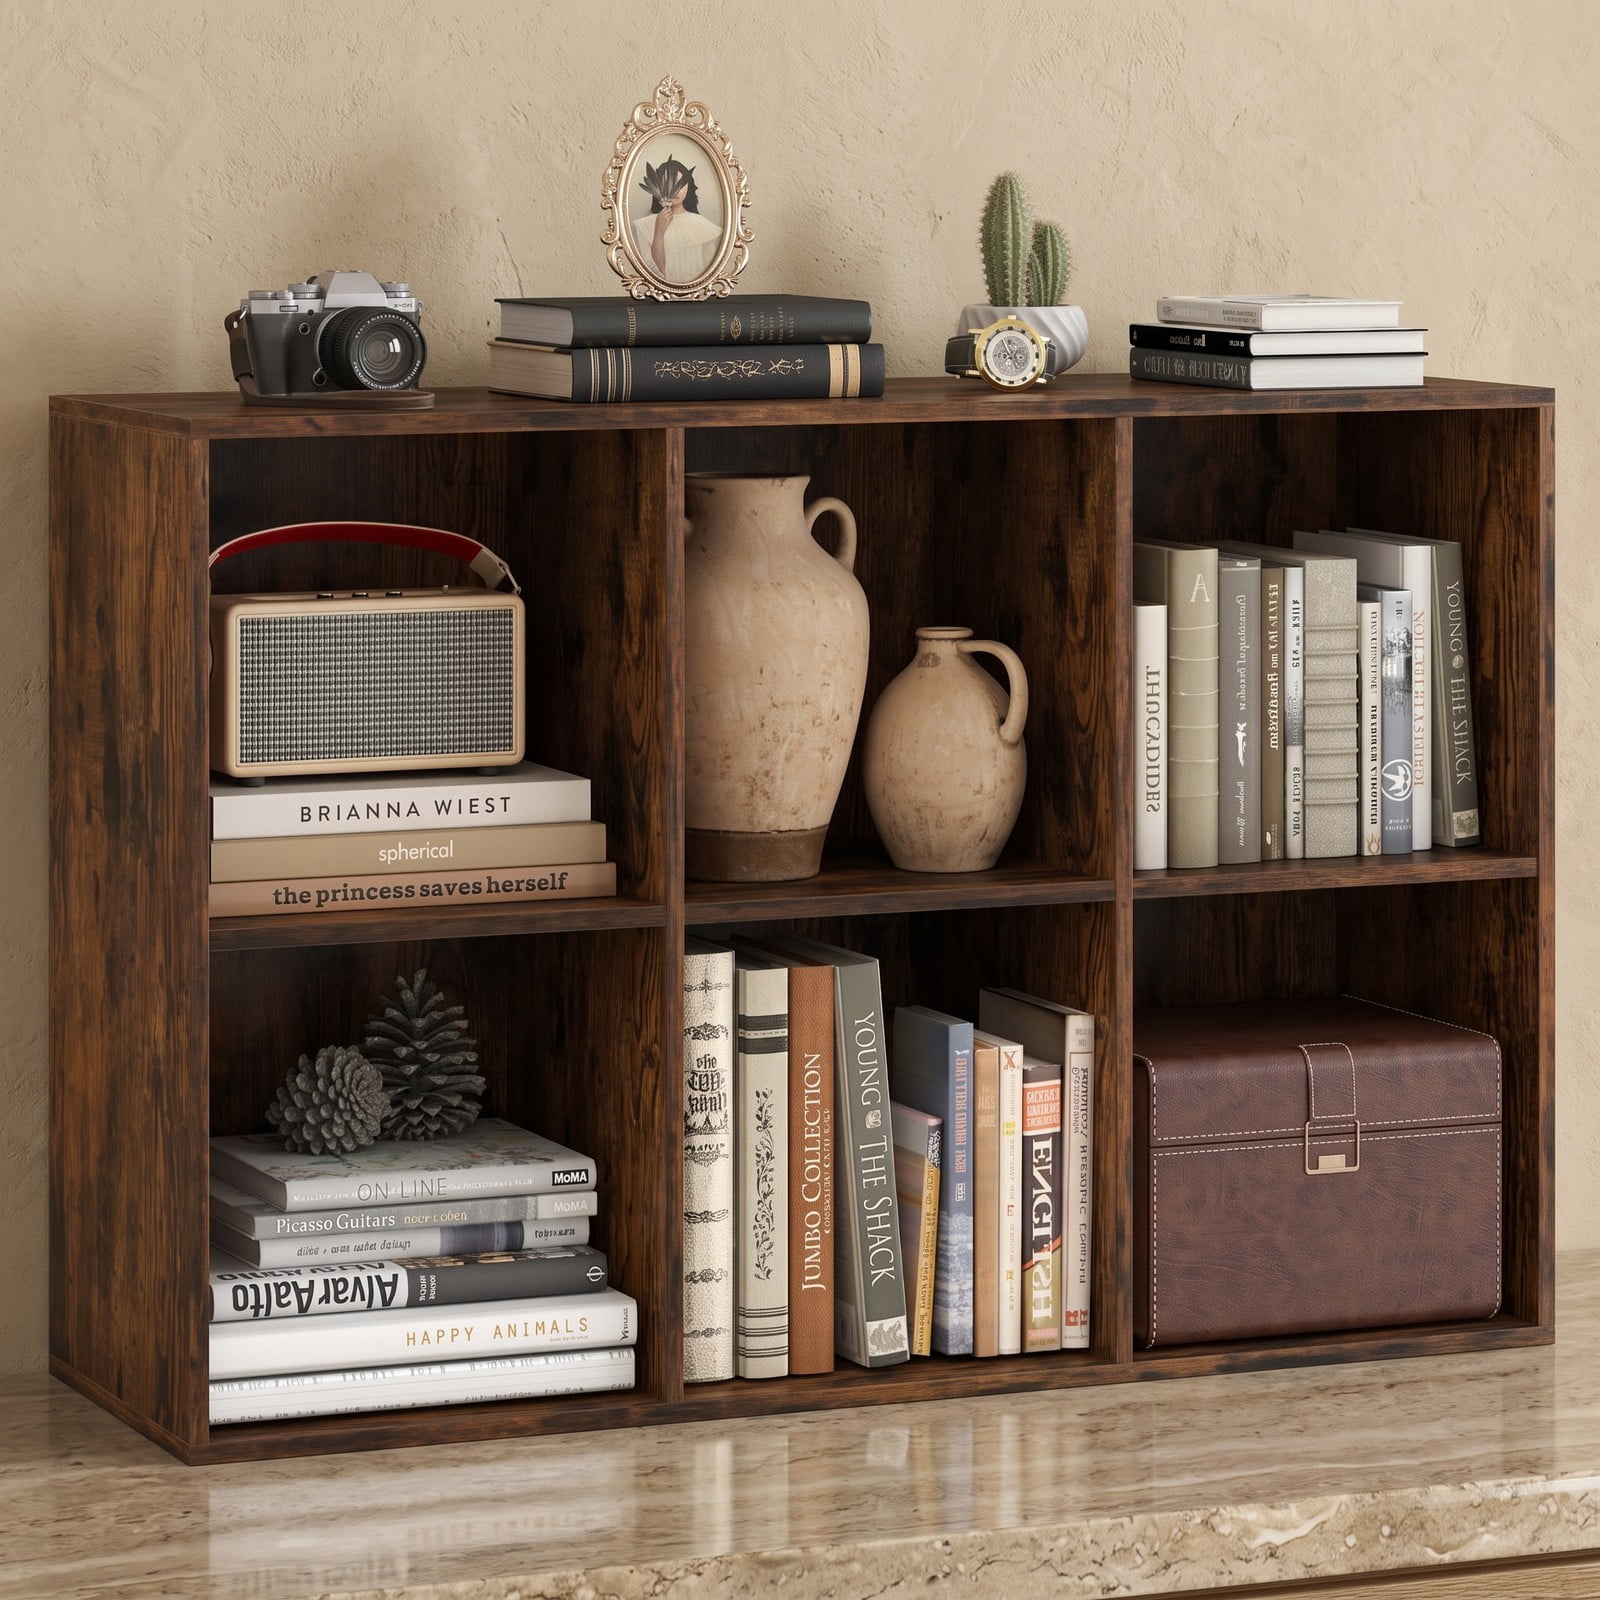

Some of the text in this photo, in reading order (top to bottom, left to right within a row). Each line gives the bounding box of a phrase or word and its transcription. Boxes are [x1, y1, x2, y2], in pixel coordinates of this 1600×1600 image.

[1446, 580, 1472, 786] YOUNG THE SHACK
[300, 796, 512, 823] BRIANNA WIEST
[378, 840, 454, 865] spherical
[273, 872, 569, 908] the princess saves herself
[854, 1011, 896, 1287] YOUNG THE SHACK
[554, 1171, 587, 1184] MoMA
[801, 1052, 826, 1292] JUMBO COLLECTION
[357, 1182, 389, 1201] ON
[401, 1177, 448, 1199] LINE
[553, 1200, 588, 1213] MoMA
[275, 1216, 333, 1234] Picasso
[336, 1213, 395, 1231] Guitars
[232, 1279, 315, 1318] Aalto
[318, 1273, 399, 1309] Alvar
[406, 1317, 589, 1346] HAPPY ANIMALS
